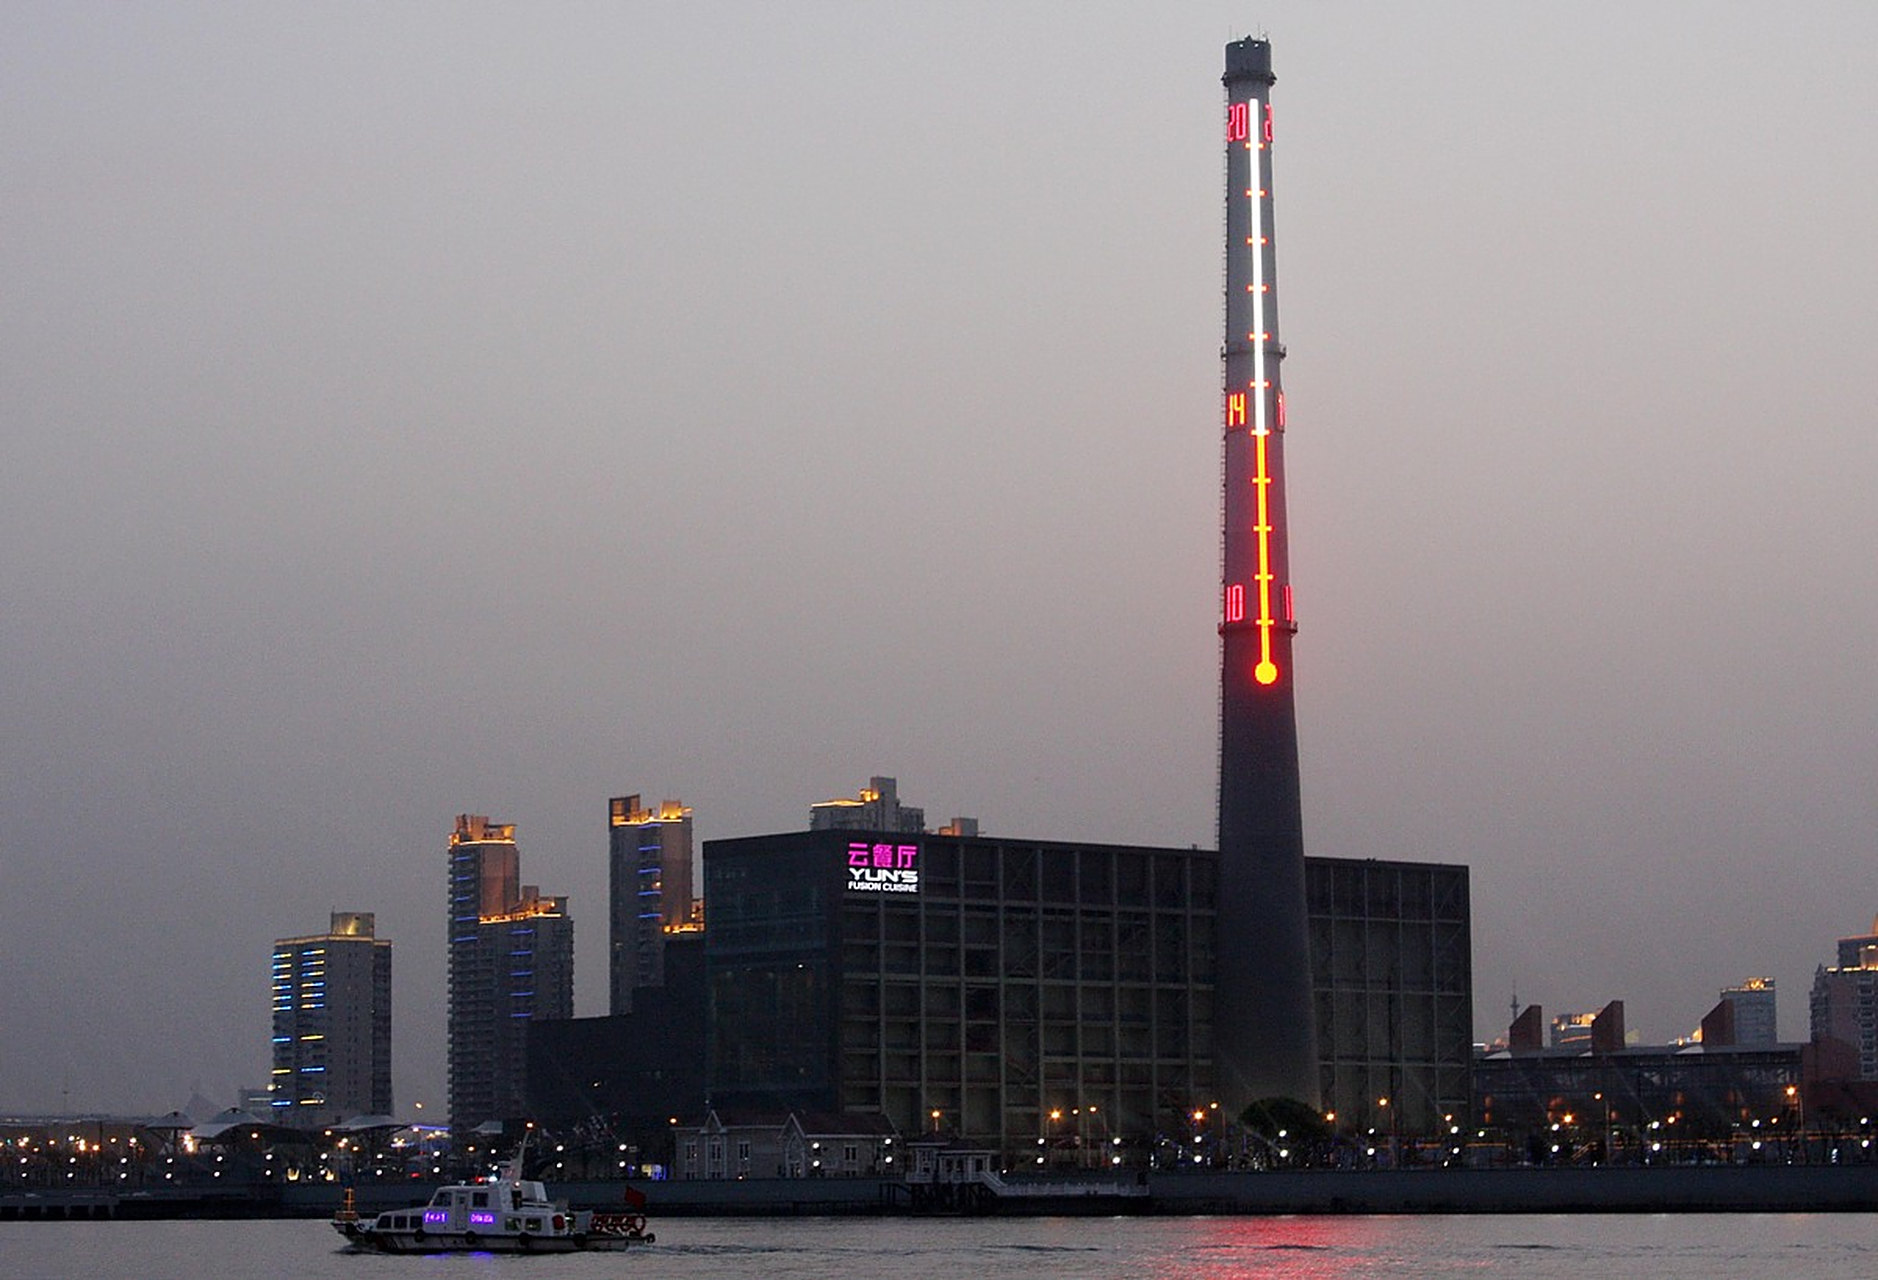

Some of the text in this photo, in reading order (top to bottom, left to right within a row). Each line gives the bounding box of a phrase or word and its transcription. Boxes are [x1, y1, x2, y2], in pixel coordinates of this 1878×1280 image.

[1227, 103, 1247, 141] 20
[1229, 393, 1245, 426] 14
[1226, 585, 1243, 621] 10
[848, 842, 917, 868] 云餐厅
[848, 881, 918, 893] FUSION CUISINE
[849, 868, 918, 883] YUN'S
